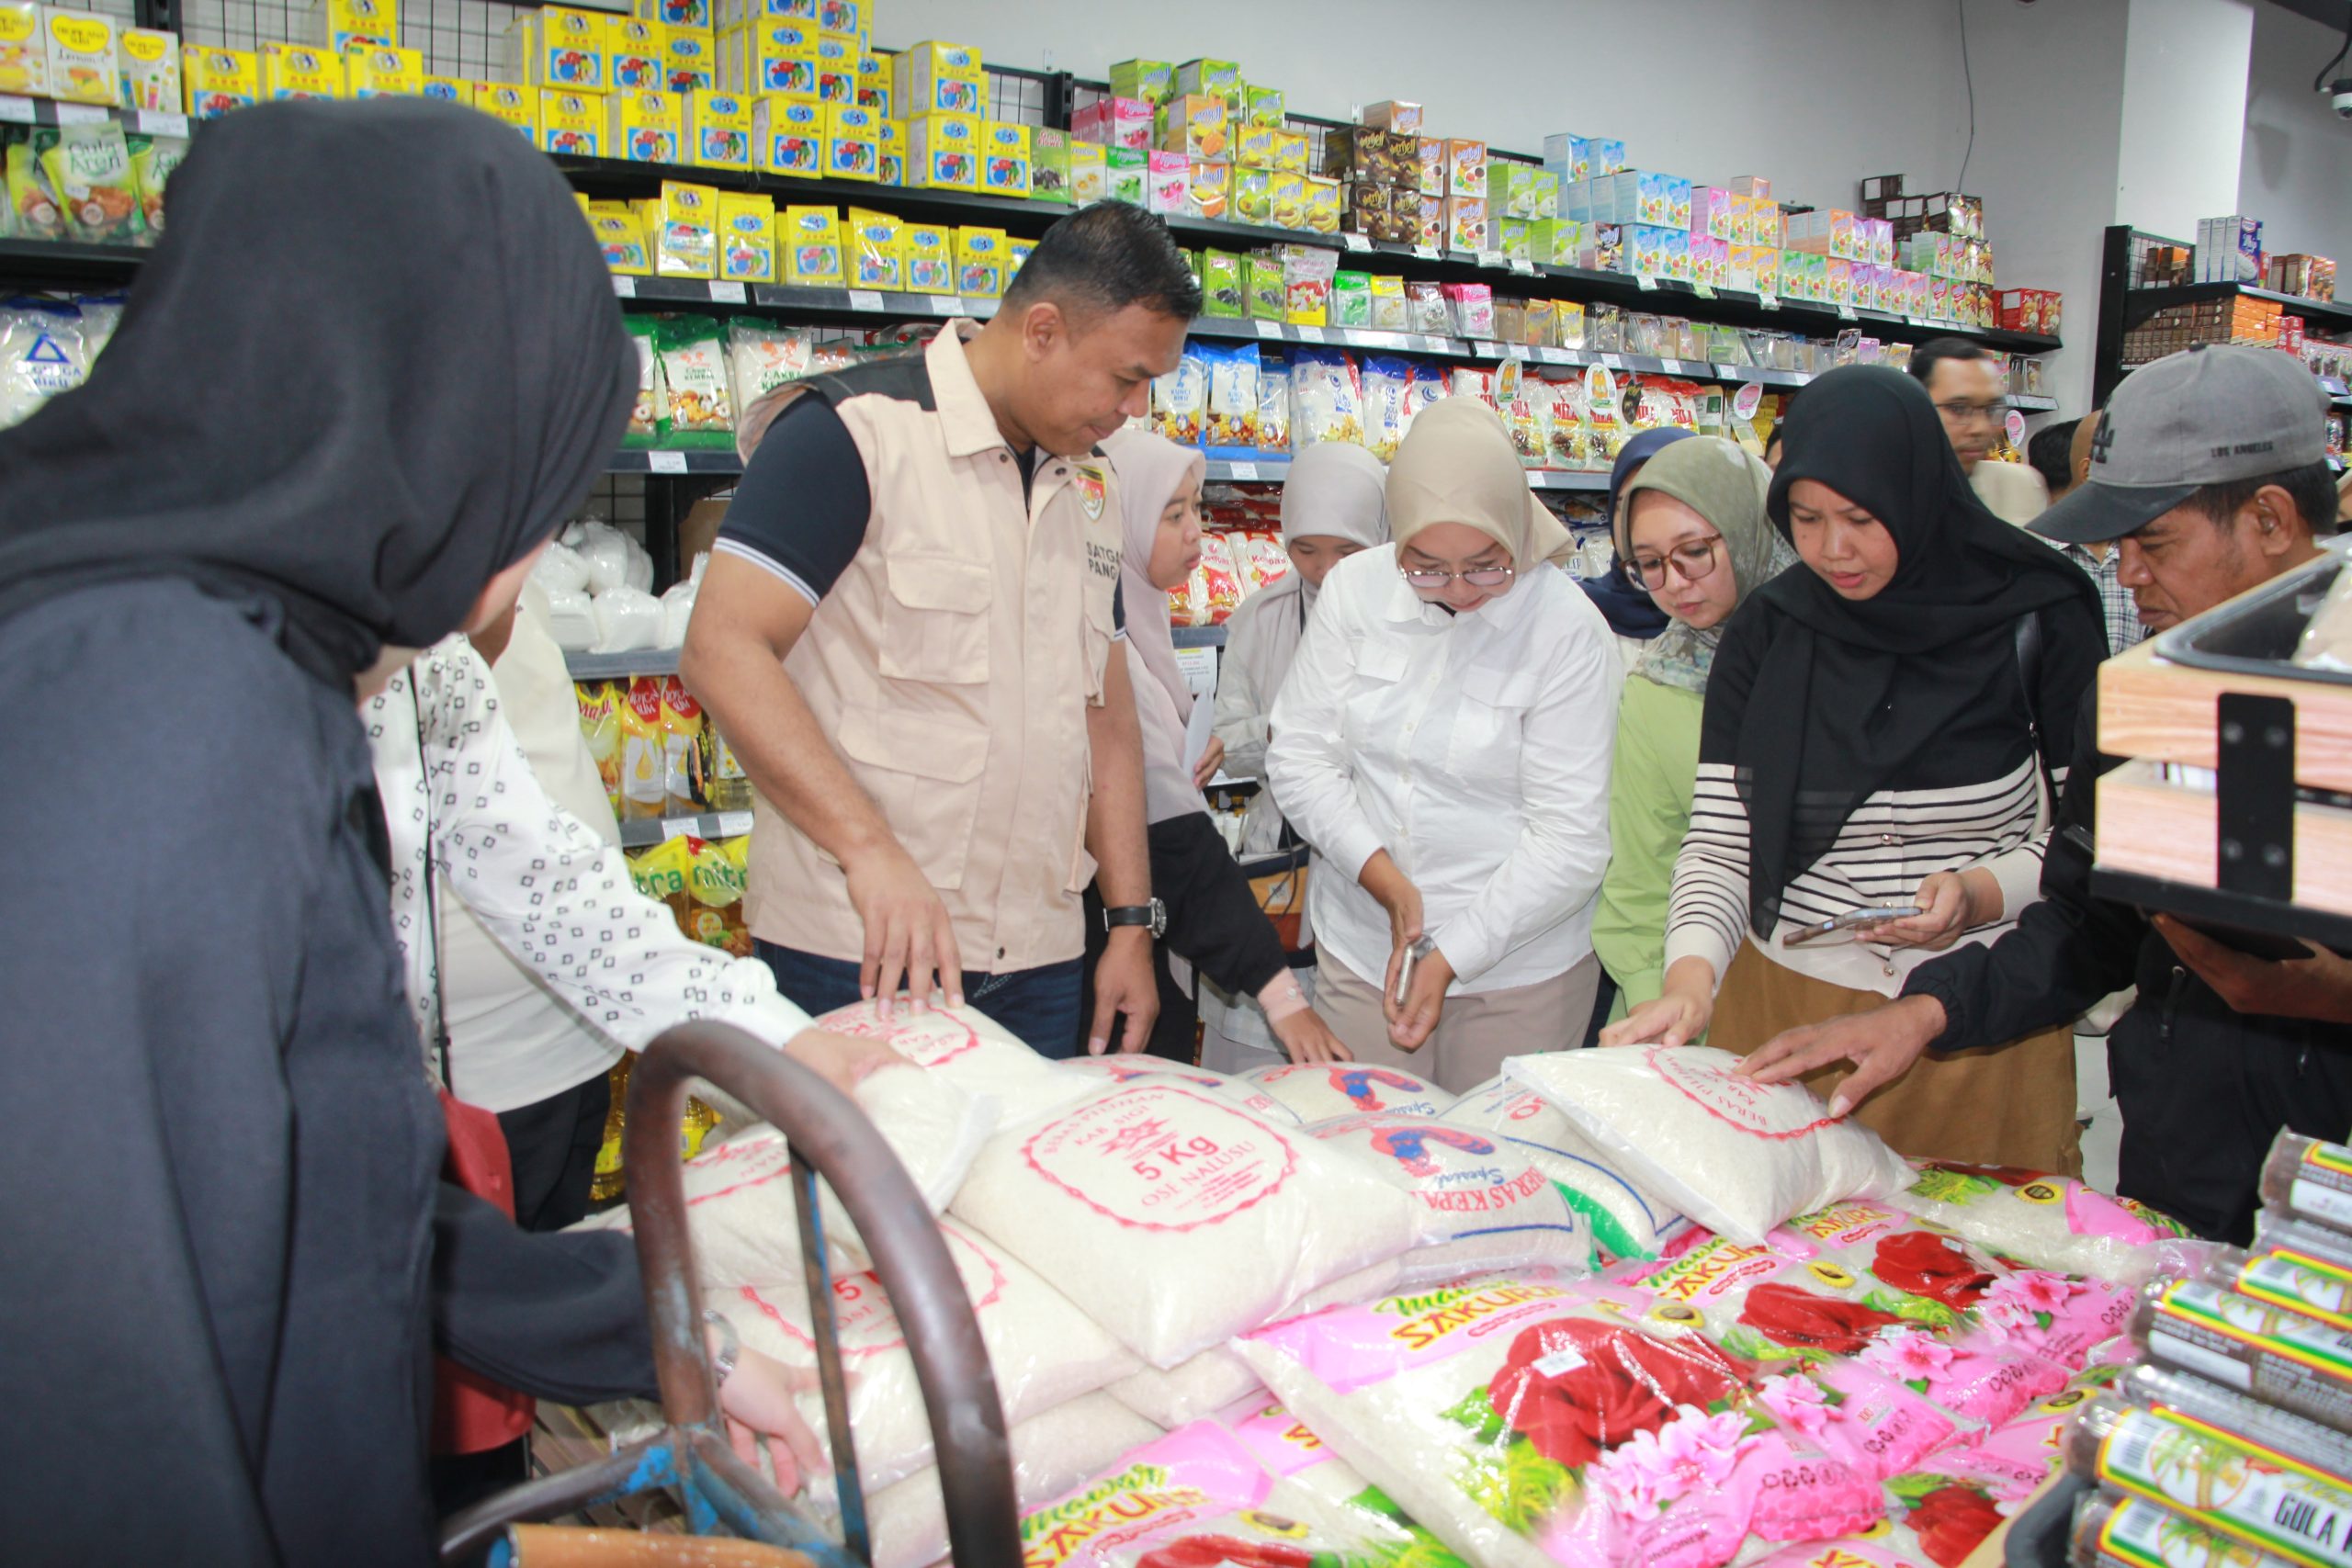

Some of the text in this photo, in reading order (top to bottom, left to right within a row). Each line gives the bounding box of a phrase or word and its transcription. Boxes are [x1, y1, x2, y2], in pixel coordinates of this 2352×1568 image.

[70, 152, 121, 175] Aren
[2211, 440, 2274, 458] LOS ANGELES
[1089, 558, 1118, 581] PANG
[634, 868, 684, 896] tra
[1716, 1093, 1769, 1128] BERAS
[1726, 1083, 1757, 1107] KAB
[1073, 1125, 1109, 1147] KAB
[1112, 1104, 1151, 1126] SIGI
[1131, 1160, 1162, 1181] 5
[1157, 1134, 1220, 1167] Kg
[1140, 1179, 1183, 1208] OSE
[1179, 1139, 1258, 1187] NALUSU
[1488, 1165, 1548, 1211] BERAS
[1634, 1234, 1729, 1288] Mawa
[831, 1278, 864, 1302] 5
[1391, 1284, 1578, 1350] SAKURA
[2274, 1490, 2340, 1546] GULA
